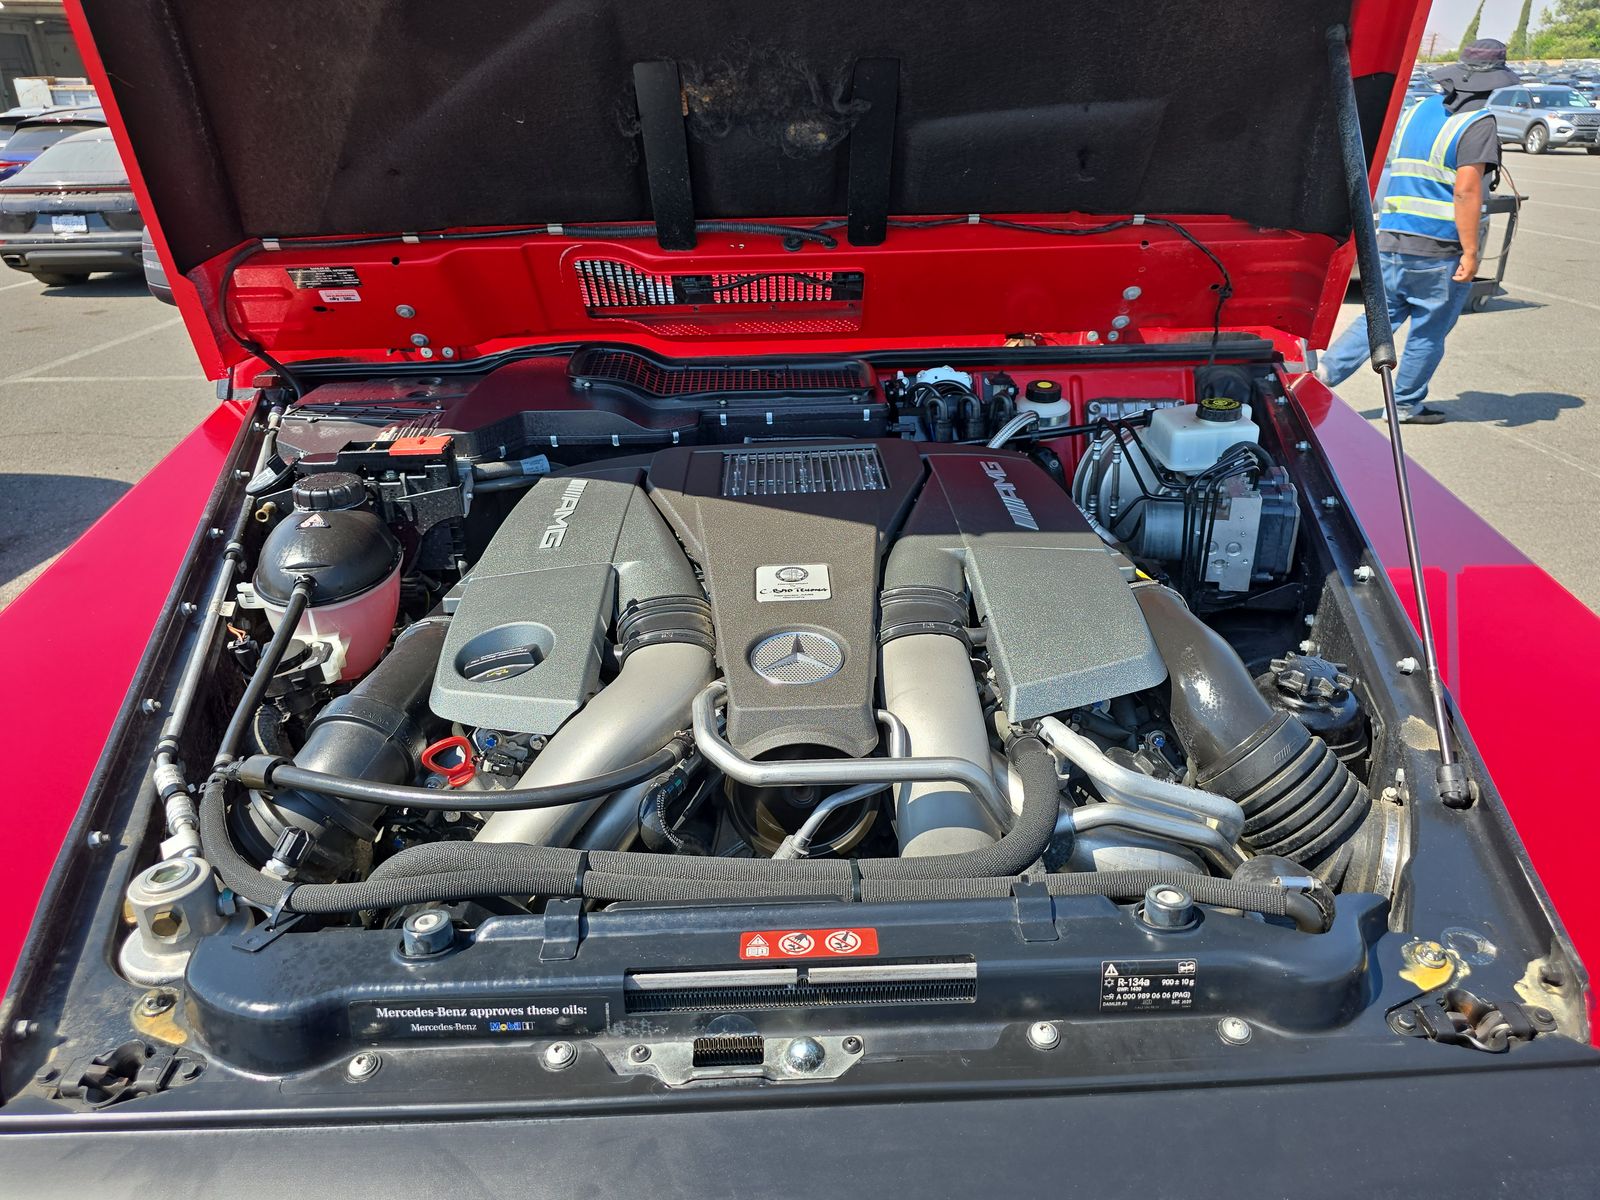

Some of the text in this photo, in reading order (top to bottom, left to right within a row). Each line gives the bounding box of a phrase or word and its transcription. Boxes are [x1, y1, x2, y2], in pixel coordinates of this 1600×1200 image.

[539, 496, 580, 549] AMG
[1117, 978, 1150, 986] R-134a
[376, 1004, 588, 1019] Mercedes-Benz approves these oils:
[410, 1022, 477, 1032] Mercedes-Benz
[489, 1021, 521, 1031] Mobil
